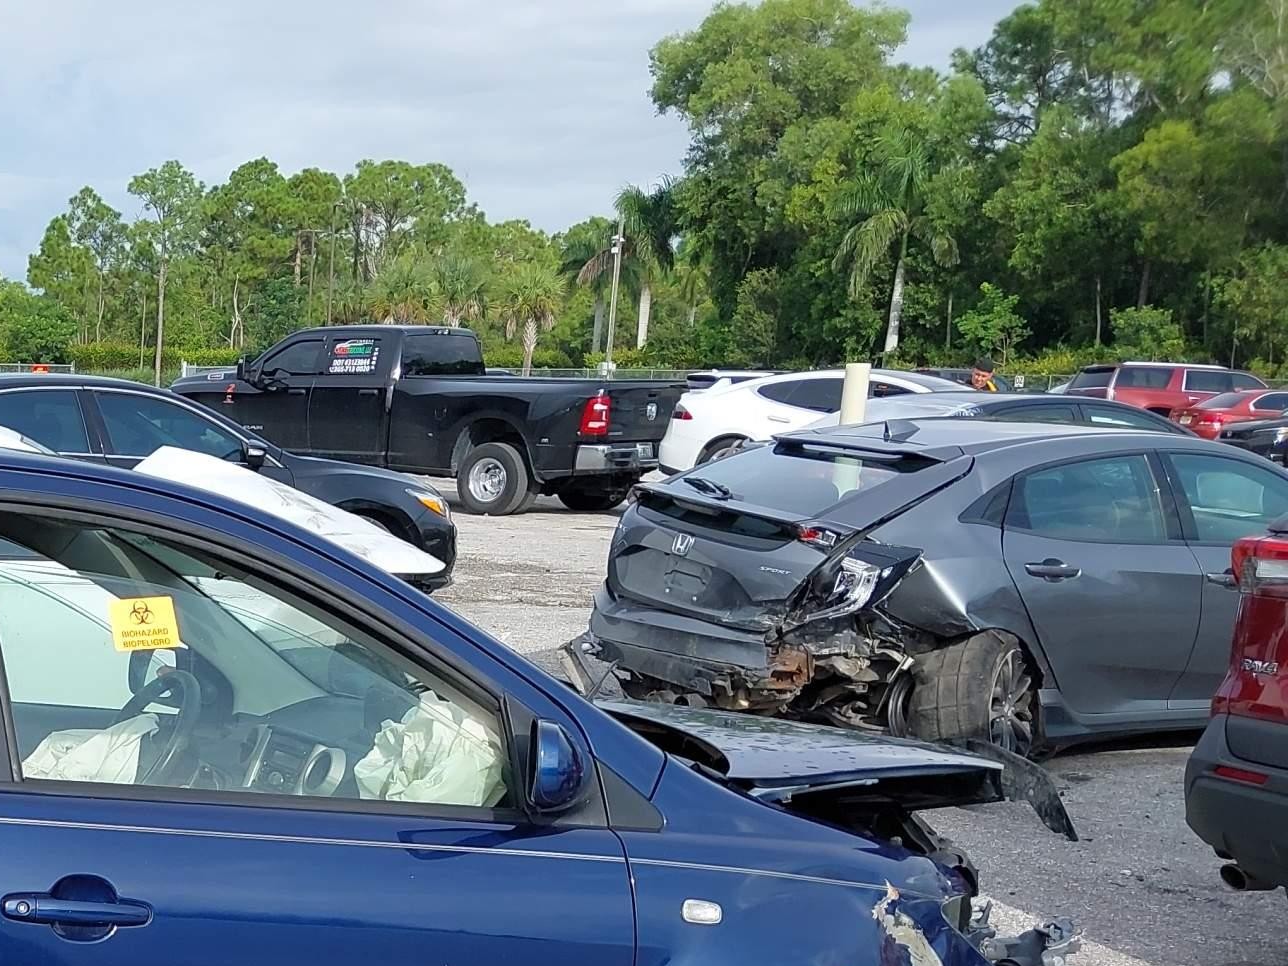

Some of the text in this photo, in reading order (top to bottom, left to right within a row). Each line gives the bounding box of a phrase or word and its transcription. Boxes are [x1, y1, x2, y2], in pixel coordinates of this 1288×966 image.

[760, 566, 792, 575] SPORT
[121, 628, 169, 638] BIOHAZARD
[123, 638, 171, 648] BIOPELIGRO
[1242, 658, 1279, 673] RAV4
